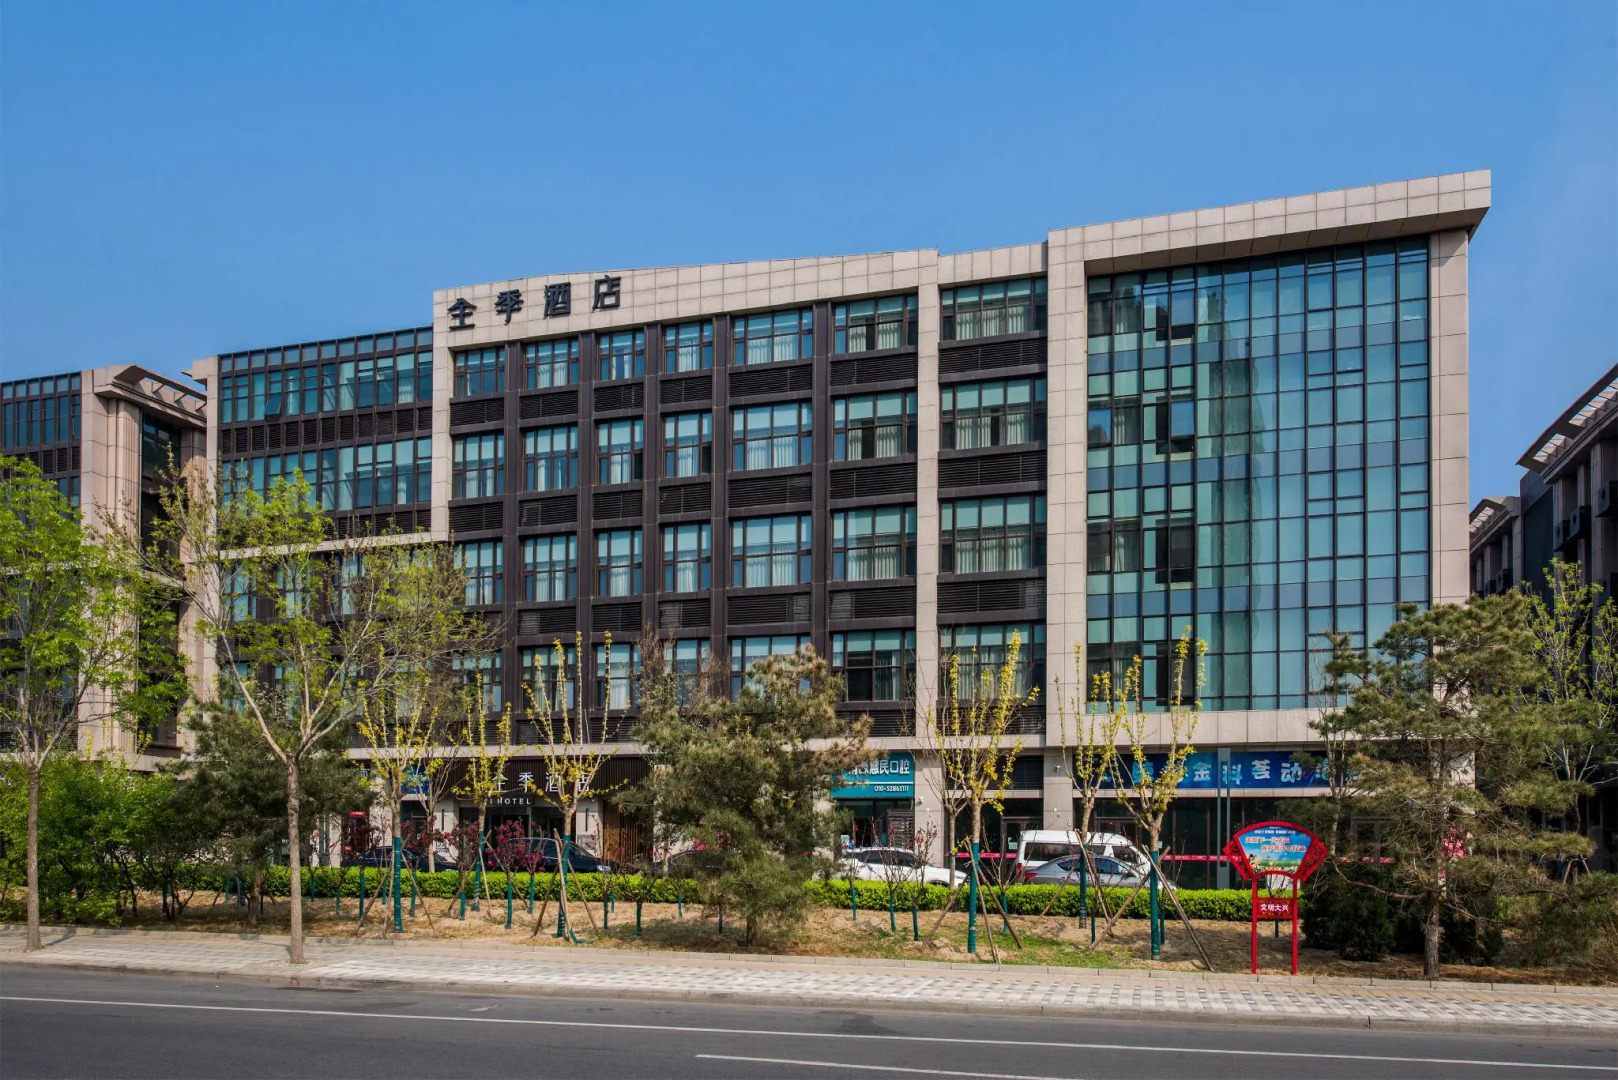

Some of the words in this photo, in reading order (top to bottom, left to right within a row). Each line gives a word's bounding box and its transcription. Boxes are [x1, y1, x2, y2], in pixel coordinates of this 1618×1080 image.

[448, 275, 621, 329] 全季酒店
[497, 797, 531, 805] HOTEL
[1260, 903, 1289, 912] 文明大兴
